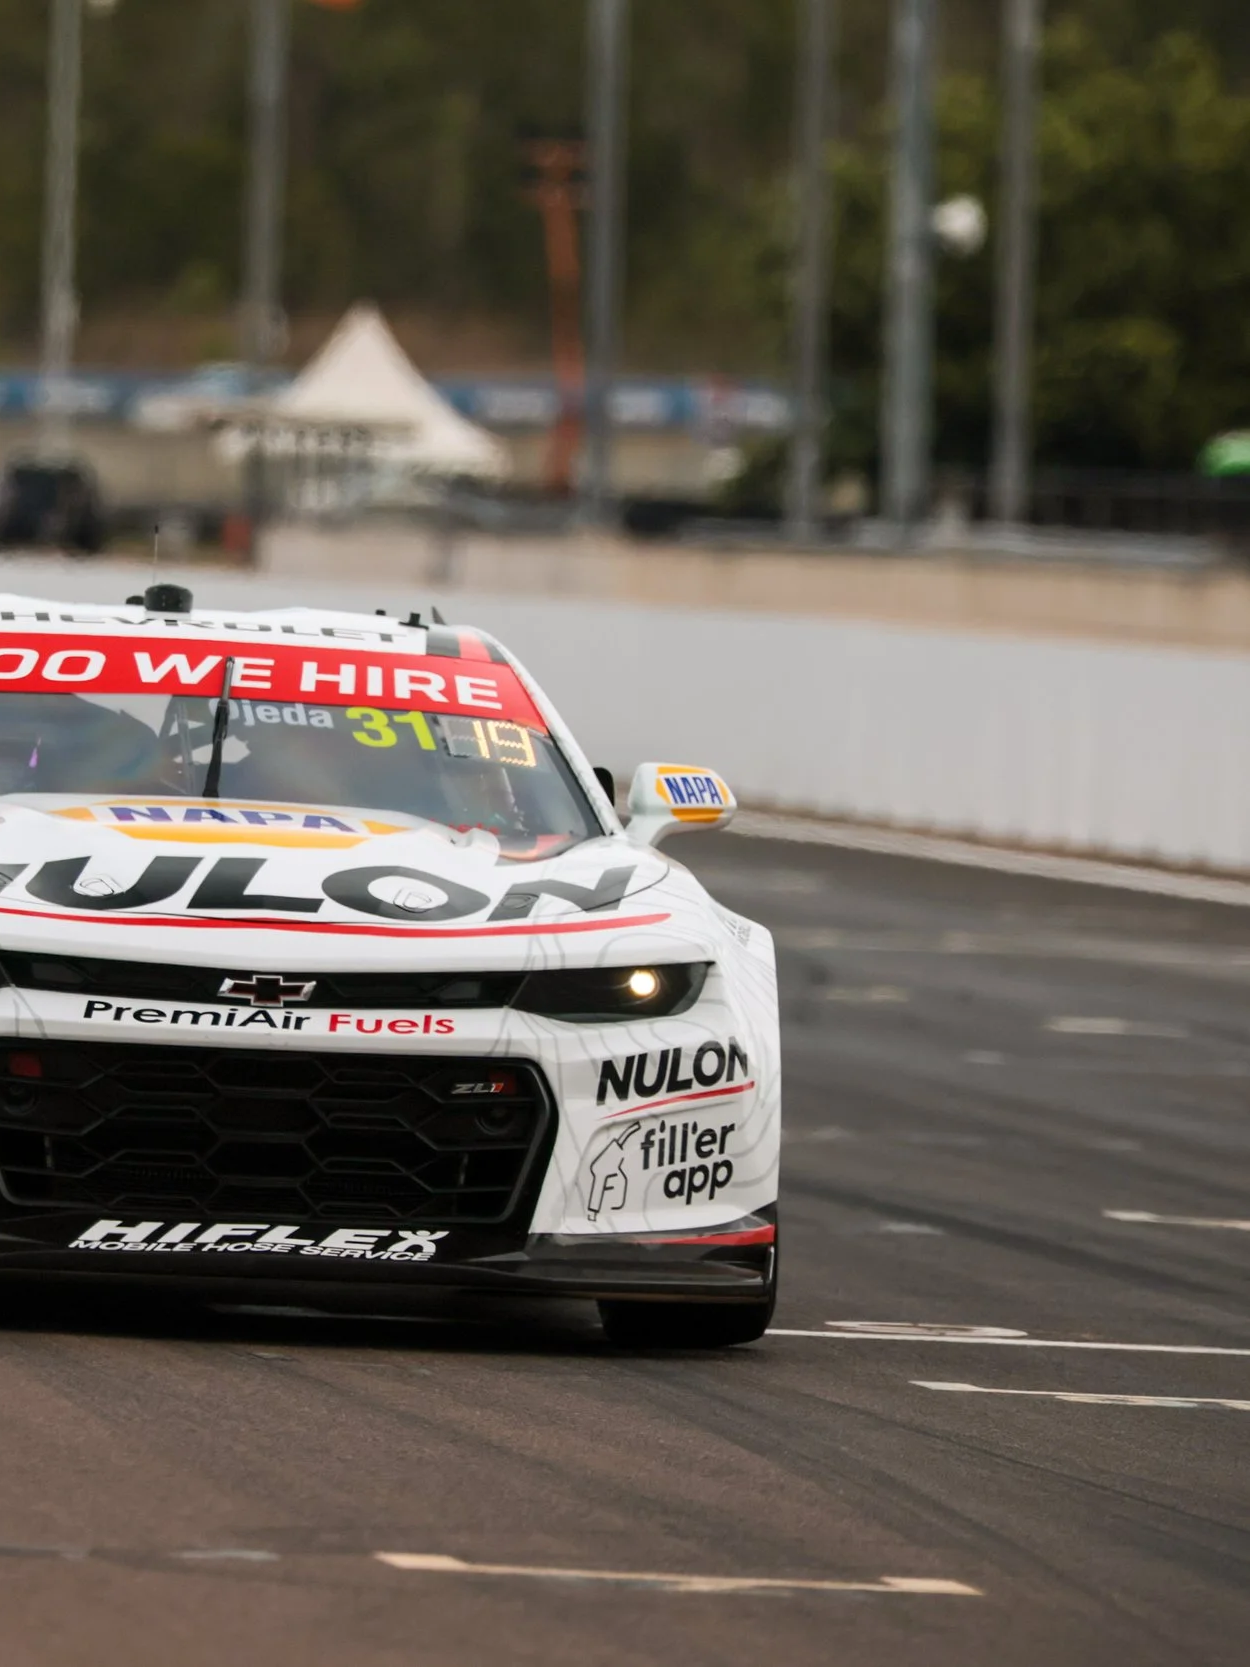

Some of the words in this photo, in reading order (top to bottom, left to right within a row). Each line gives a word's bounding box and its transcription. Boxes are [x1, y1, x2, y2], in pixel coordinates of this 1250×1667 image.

[133, 651, 274, 689] WE
[299, 662, 503, 709] HIRE
[208, 698, 334, 728] Ojeda
[345, 707, 437, 750] 31
[663, 775, 725, 805] NAPA
[107, 806, 360, 833] NAPA
[83, 1000, 311, 1031] PremiAir
[328, 1013, 456, 1035] Fuels
[596, 1035, 750, 1106] NULON
[664, 1153, 734, 1205] app
[69, 1240, 196, 1252] MOBILE
[201, 1242, 298, 1253] HOSE
[300, 1246, 434, 1262] SERVICE
[78, 1220, 449, 1253] HIFLEX
